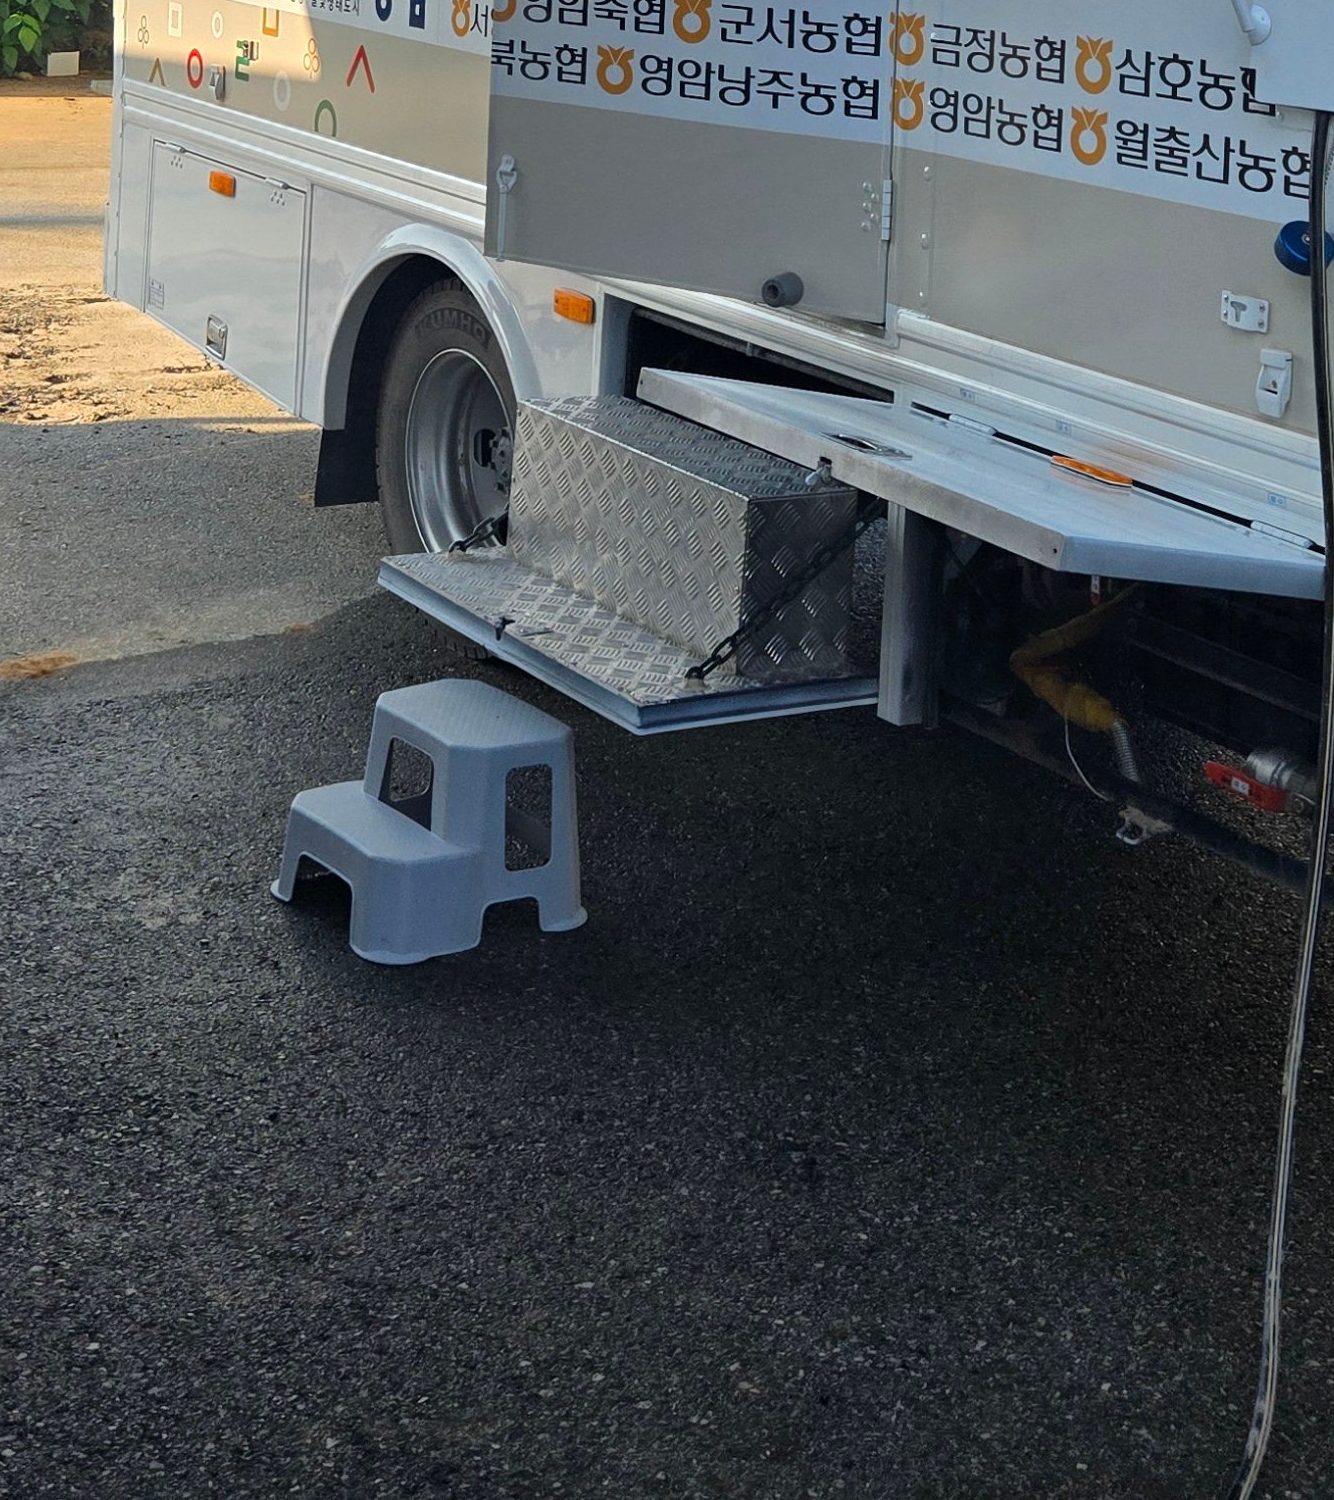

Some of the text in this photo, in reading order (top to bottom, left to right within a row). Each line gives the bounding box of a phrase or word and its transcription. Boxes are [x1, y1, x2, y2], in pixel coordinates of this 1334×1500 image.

[470, 3, 493, 38] 서
[639, 53, 881, 121] 영암낭주농협
[928, 85, 1063, 152] 영암농협
[1114, 119, 1312, 199] 월출산농협
[718, 2, 883, 57] 군서농협
[929, 22, 1067, 85] 금정농협
